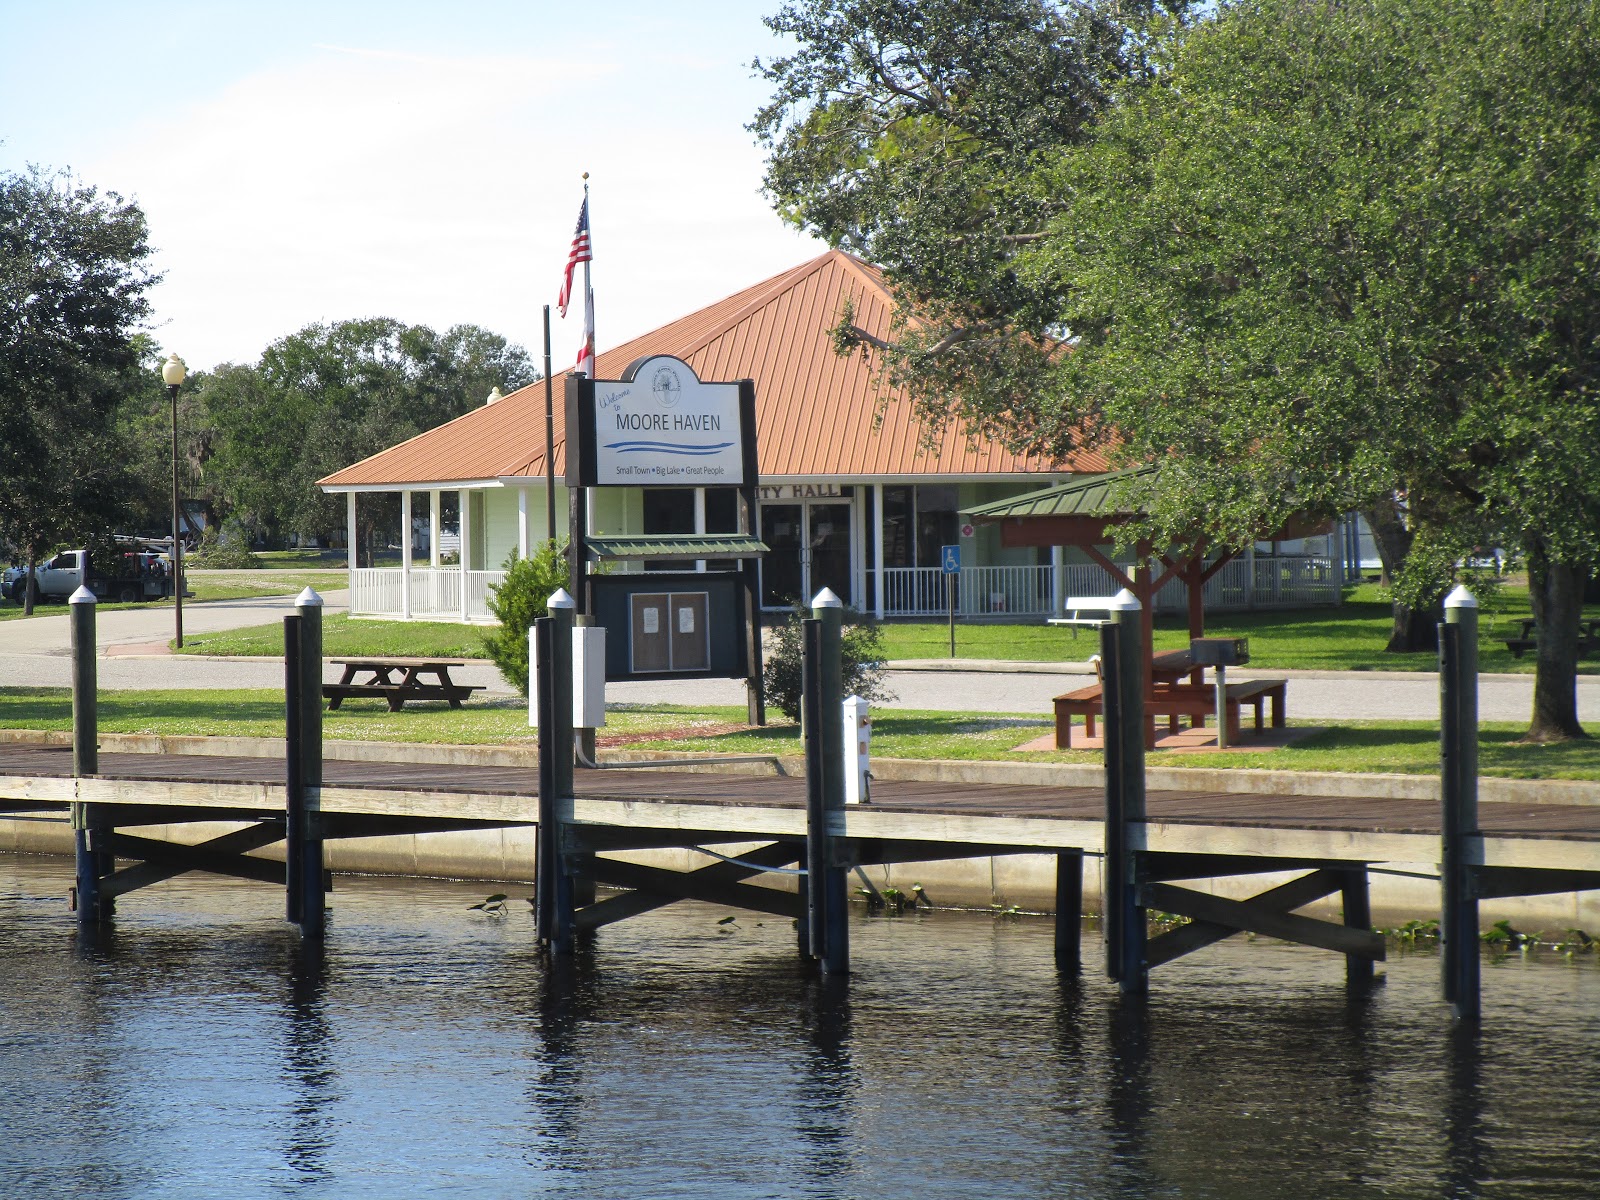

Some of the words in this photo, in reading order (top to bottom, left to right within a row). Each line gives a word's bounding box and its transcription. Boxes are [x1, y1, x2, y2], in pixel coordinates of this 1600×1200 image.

[598, 389, 631, 409] Welcome
[616, 413, 669, 431] MOORE
[674, 414, 721, 431] HAVEN
[616, 465, 633, 475] Small
[634, 465, 651, 475] Town
[656, 465, 666, 477] Big
[667, 465, 680, 475] Lake
[686, 466, 703, 475] Great
[703, 465, 725, 476] People
[755, 486, 783, 499] ITY
[792, 484, 838, 497] HALL
